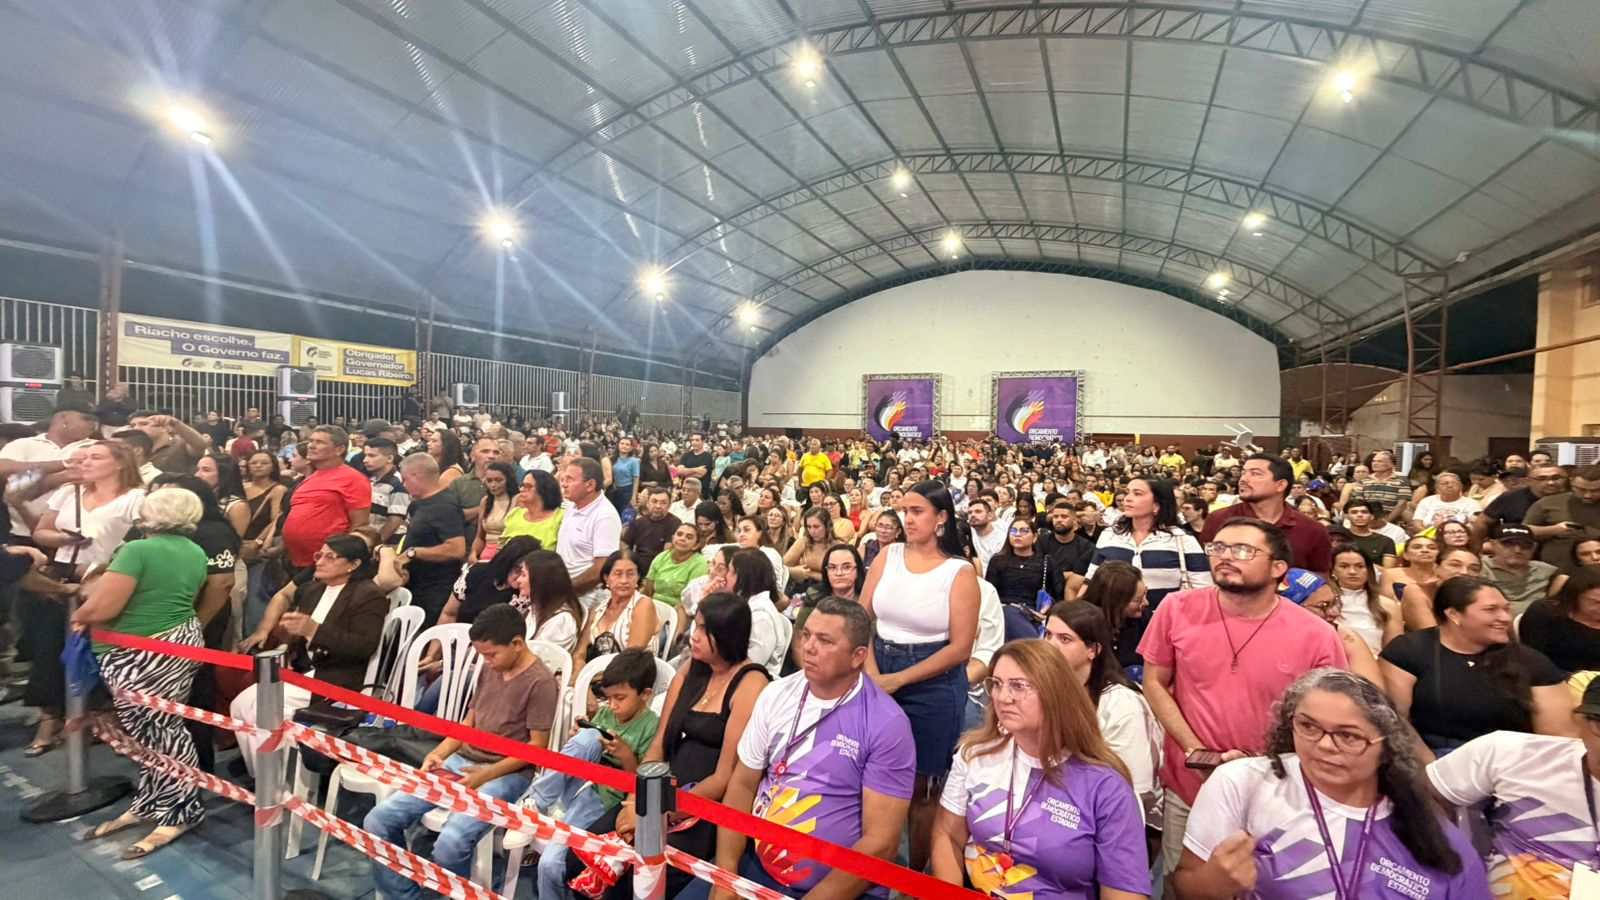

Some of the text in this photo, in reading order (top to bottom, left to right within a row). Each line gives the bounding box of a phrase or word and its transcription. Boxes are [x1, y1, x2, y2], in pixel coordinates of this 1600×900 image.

[134, 325, 253, 346] Riacho escolhe.
[182, 342, 284, 361] O Governo faz.
[346, 349, 394, 361] Obrigado!
[346, 358, 403, 370] Governador
[346, 367, 377, 376] Lucas
